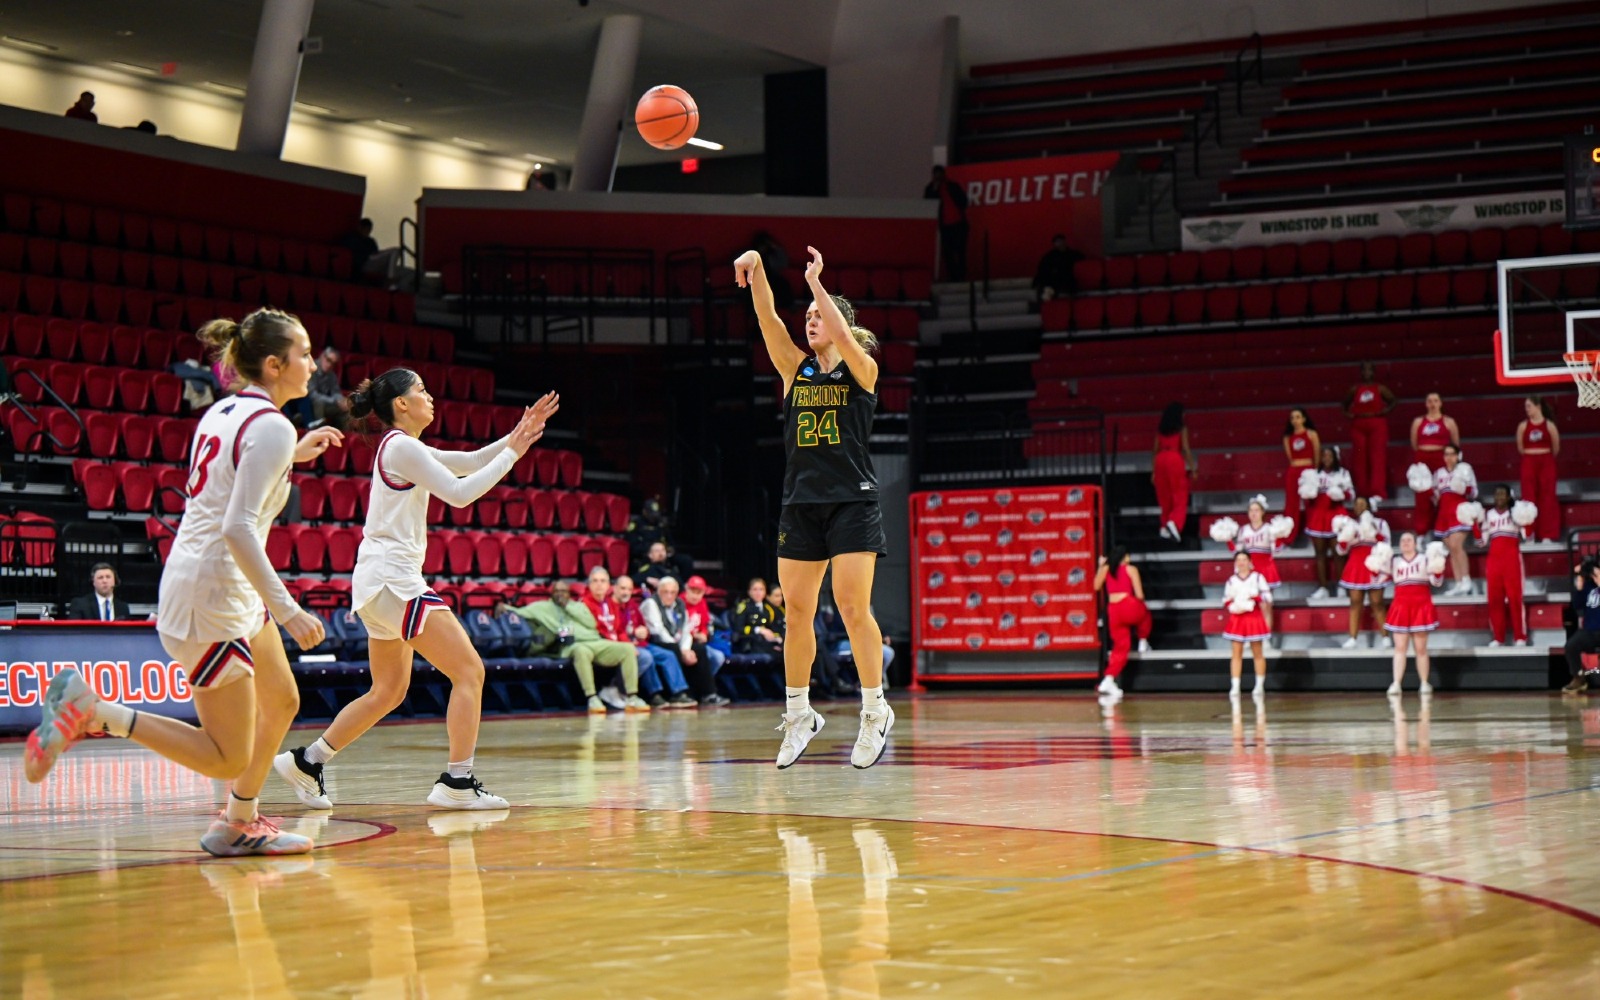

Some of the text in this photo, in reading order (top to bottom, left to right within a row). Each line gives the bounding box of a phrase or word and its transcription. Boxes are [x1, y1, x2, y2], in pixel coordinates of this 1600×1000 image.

[1474, 198, 1564, 219] WINGSTOP IS
[1260, 213, 1380, 234] WINGSTOP IS HERE
[791, 384, 850, 407] VERMONT
[797, 409, 841, 447] 24
[185, 433, 221, 499] 13
